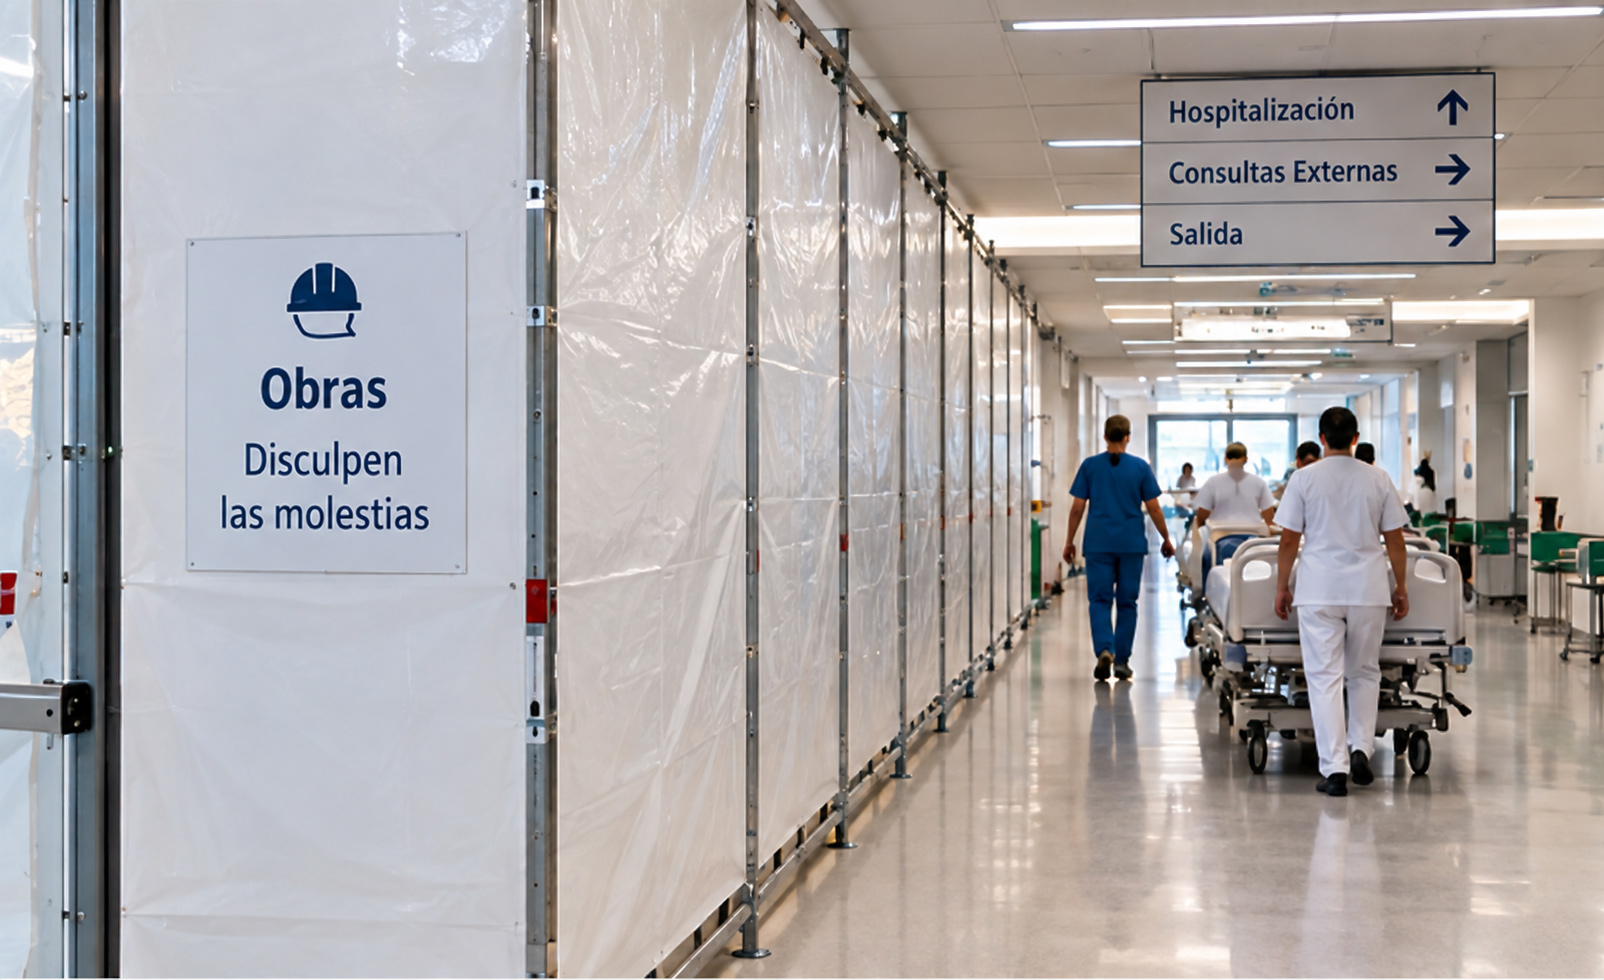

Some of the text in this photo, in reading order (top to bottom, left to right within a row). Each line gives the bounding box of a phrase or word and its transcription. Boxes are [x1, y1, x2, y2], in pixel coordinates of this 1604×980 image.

[1170, 96, 1354, 128] Hospitalización
[1169, 160, 1397, 184] Consultas Externas
[1171, 221, 1242, 245] Salida
[261, 367, 386, 410] Obras
[246, 441, 401, 484] Disculpen
[222, 495, 429, 530] las molestias
